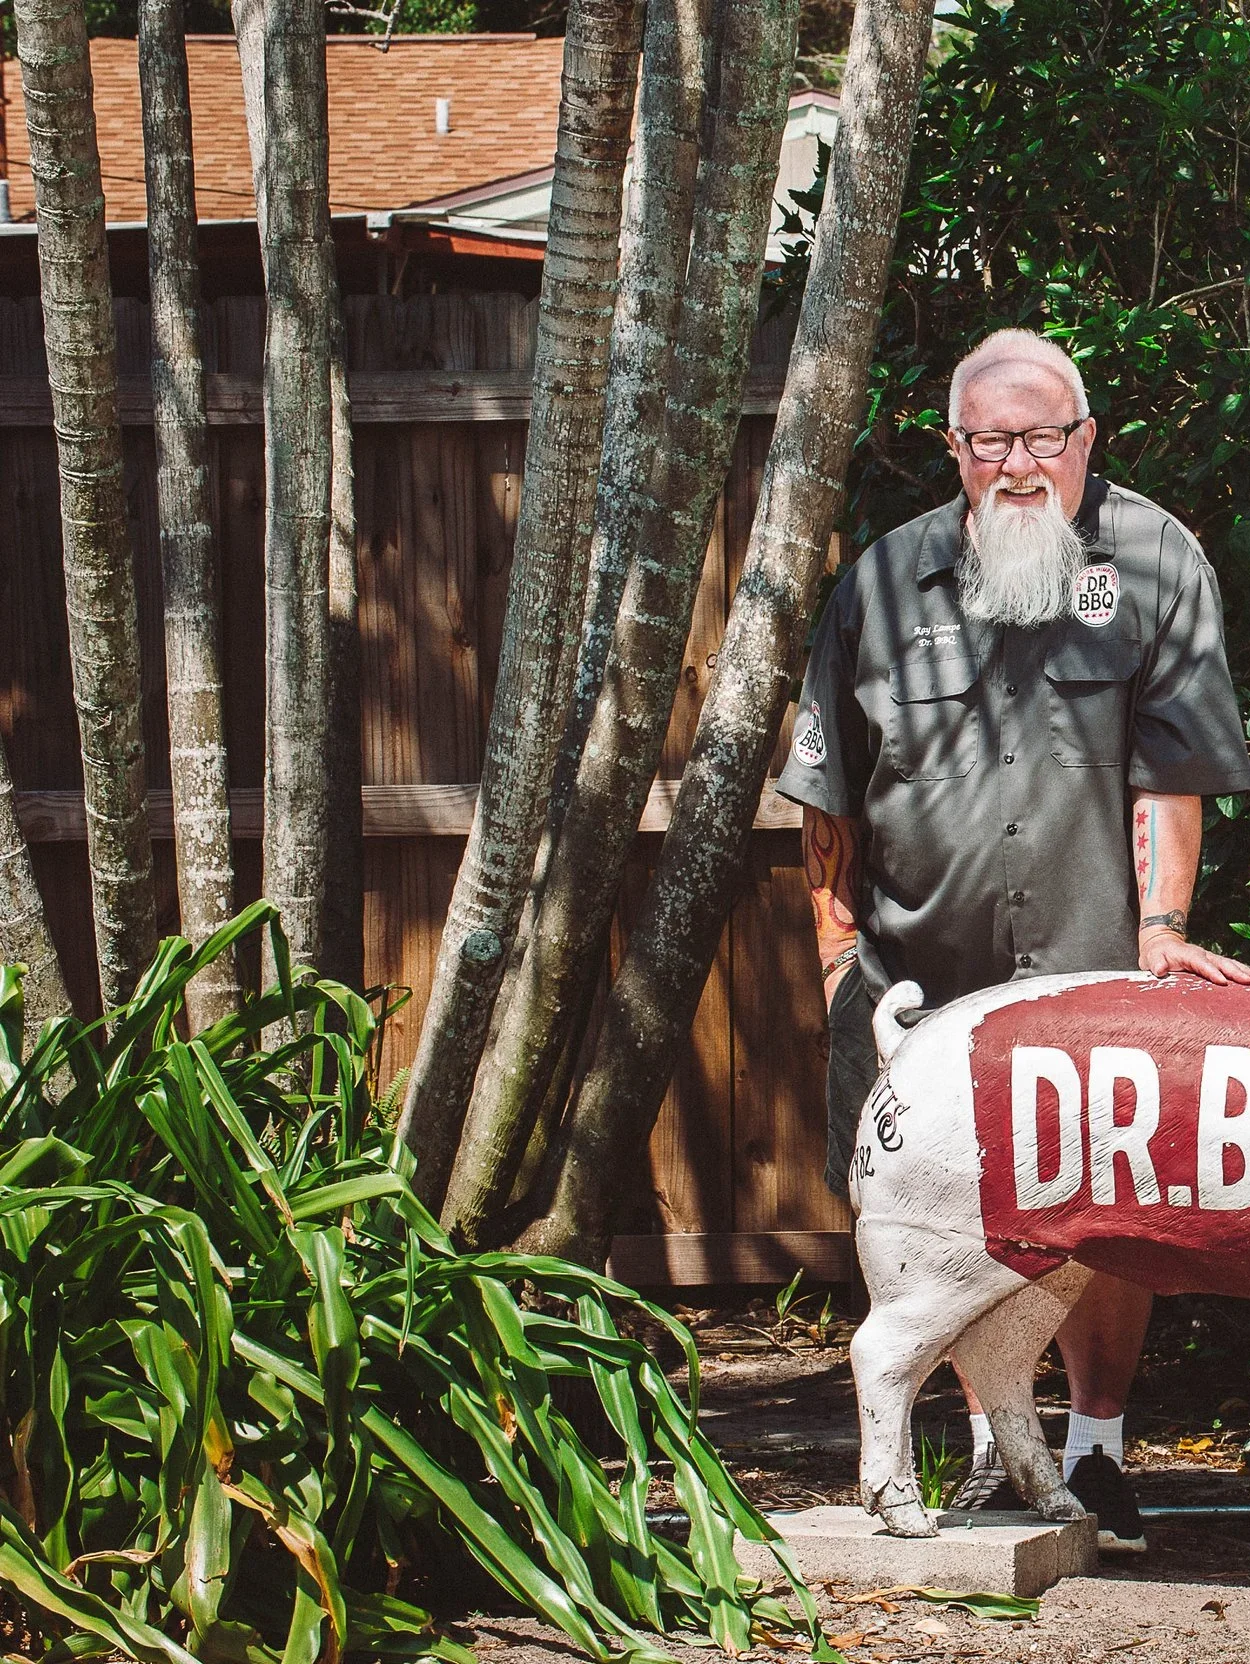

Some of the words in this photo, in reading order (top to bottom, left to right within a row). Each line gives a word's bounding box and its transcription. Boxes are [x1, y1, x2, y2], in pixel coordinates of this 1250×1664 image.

[1087, 575, 1108, 592] DR
[1078, 590, 1114, 611] BBQ
[913, 626, 931, 636] Ray
[932, 624, 961, 633] Lampe
[918, 638, 932, 647] Dr.
[799, 729, 824, 756] BBQ
